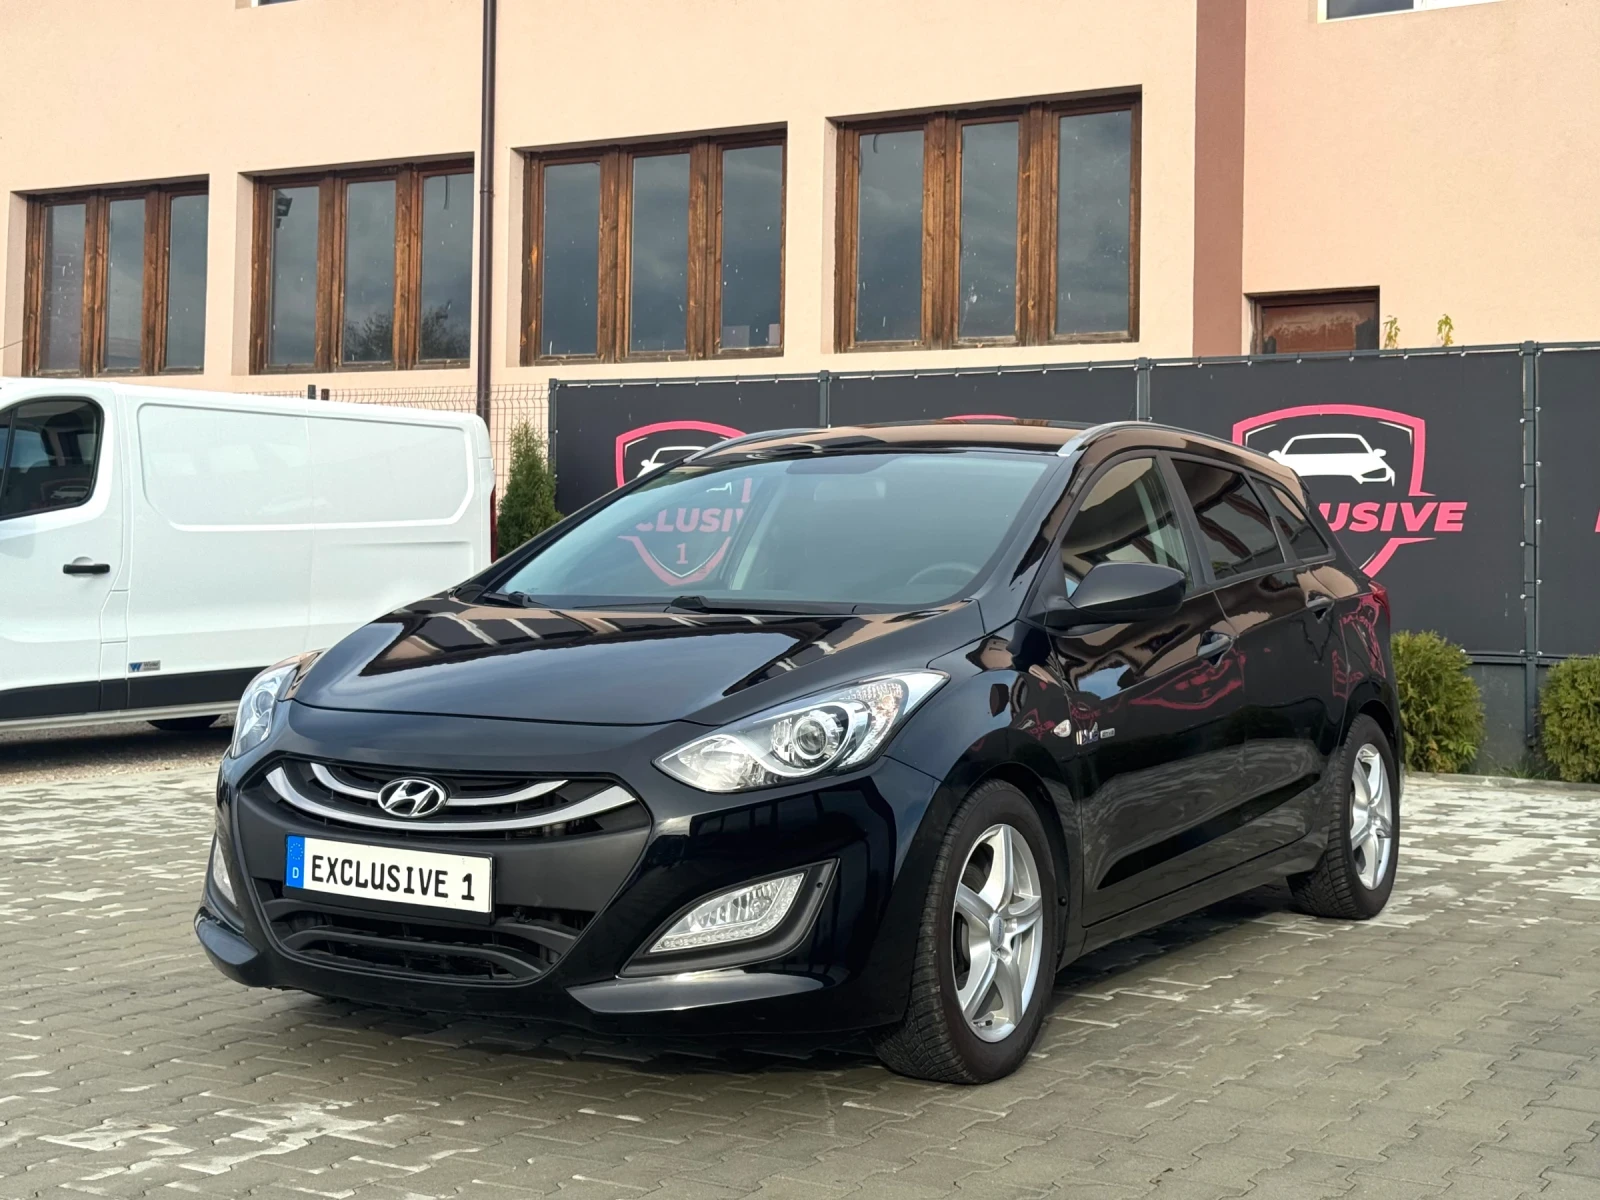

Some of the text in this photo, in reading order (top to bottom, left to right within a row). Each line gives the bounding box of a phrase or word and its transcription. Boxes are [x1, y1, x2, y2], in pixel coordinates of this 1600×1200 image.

[676, 543, 689, 565] 1
[291, 866, 300, 879] D
[311, 855, 475, 901] EXCLUSIVE 1
